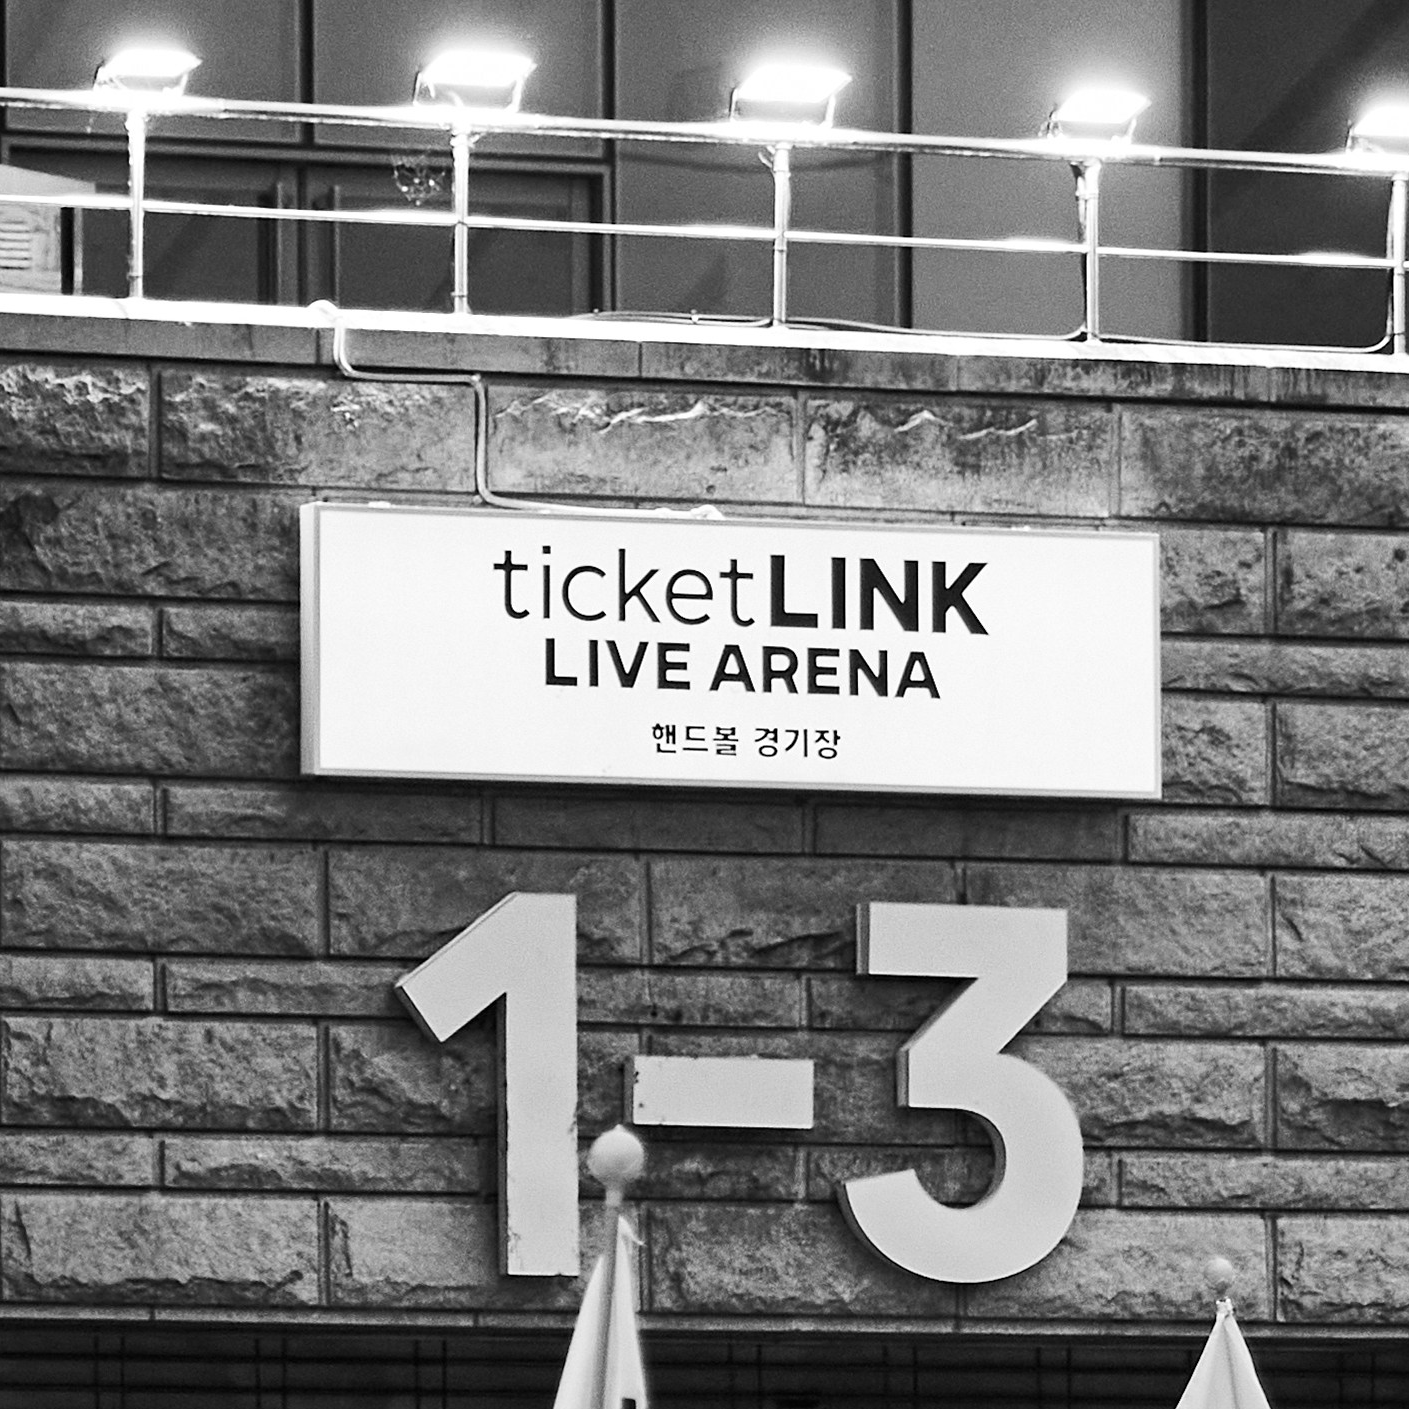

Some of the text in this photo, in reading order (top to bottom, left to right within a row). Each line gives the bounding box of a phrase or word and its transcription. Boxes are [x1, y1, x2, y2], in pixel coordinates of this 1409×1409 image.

[493, 545, 989, 635] ticketLINK
[544, 638, 940, 698] LIVE ARENA
[652, 723, 841, 759] 핸드볼 경기장
[395, 892, 1084, 1283] 1-3
